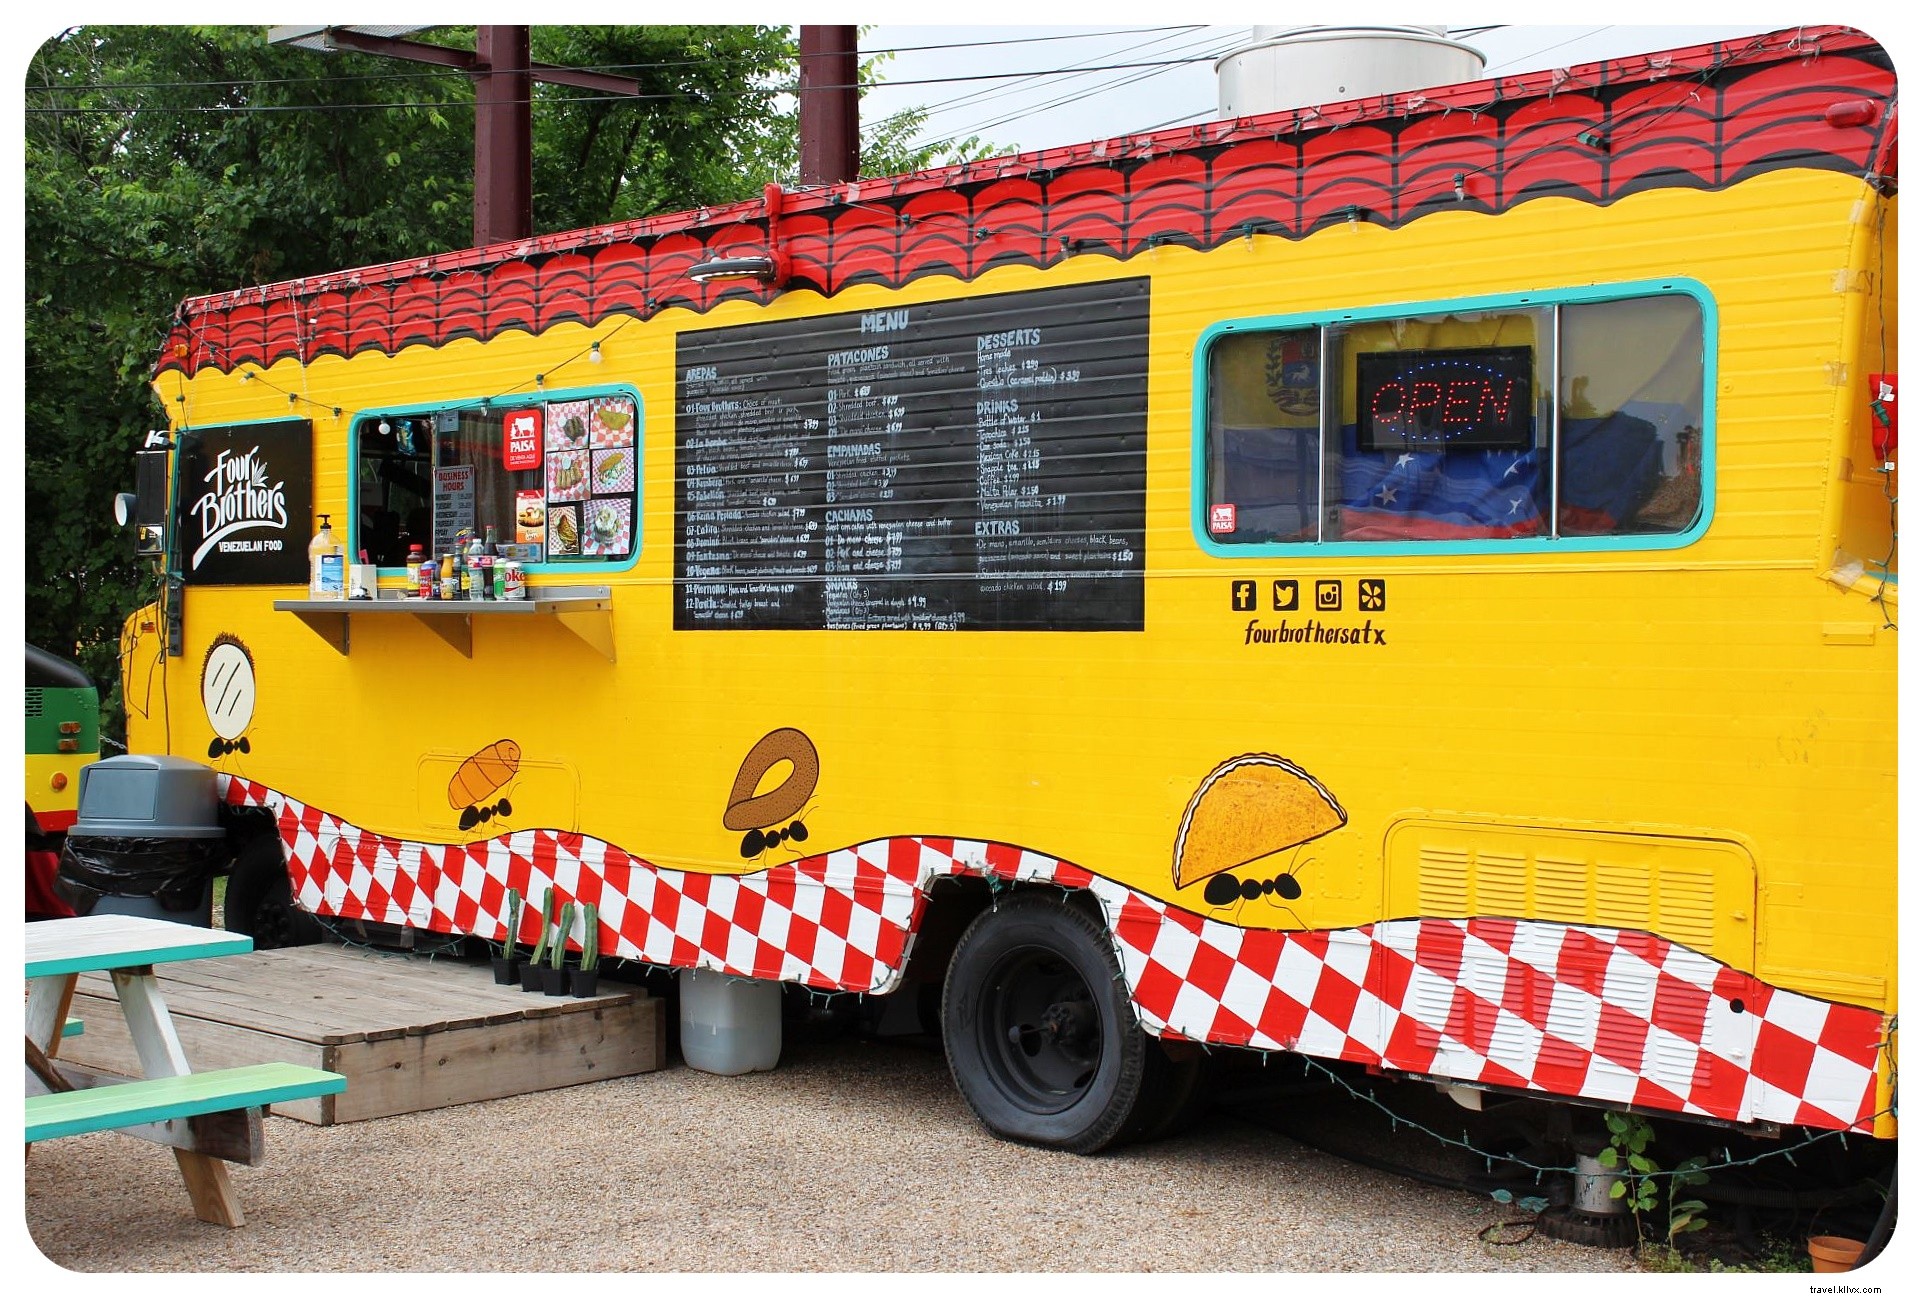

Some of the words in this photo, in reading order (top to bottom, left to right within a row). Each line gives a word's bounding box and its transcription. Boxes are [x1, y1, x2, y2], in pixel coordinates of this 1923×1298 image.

[860, 309, 909, 333] MENU
[977, 328, 1041, 351] DESSERTS
[828, 346, 890, 367] PATACONES
[686, 366, 717, 383] AREPAS
[1372, 380, 1515, 424] OPEN
[510, 439, 536, 453] PAISA
[827, 442, 881, 458] EMPANADAS
[204, 445, 260, 498] Four
[438, 471, 469, 481] BUSINESS
[443, 481, 465, 492] HOURS
[191, 480, 288, 541] Brothers
[825, 508, 873, 523] CACHAPAS
[975, 520, 1020, 536] EXTRAS
[1212, 520, 1233, 529] PAISA
[219, 541, 263, 554] VENEZUELAN
[264, 540, 283, 552] FOOD
[1245, 618, 1388, 646] fourbrothersatx
